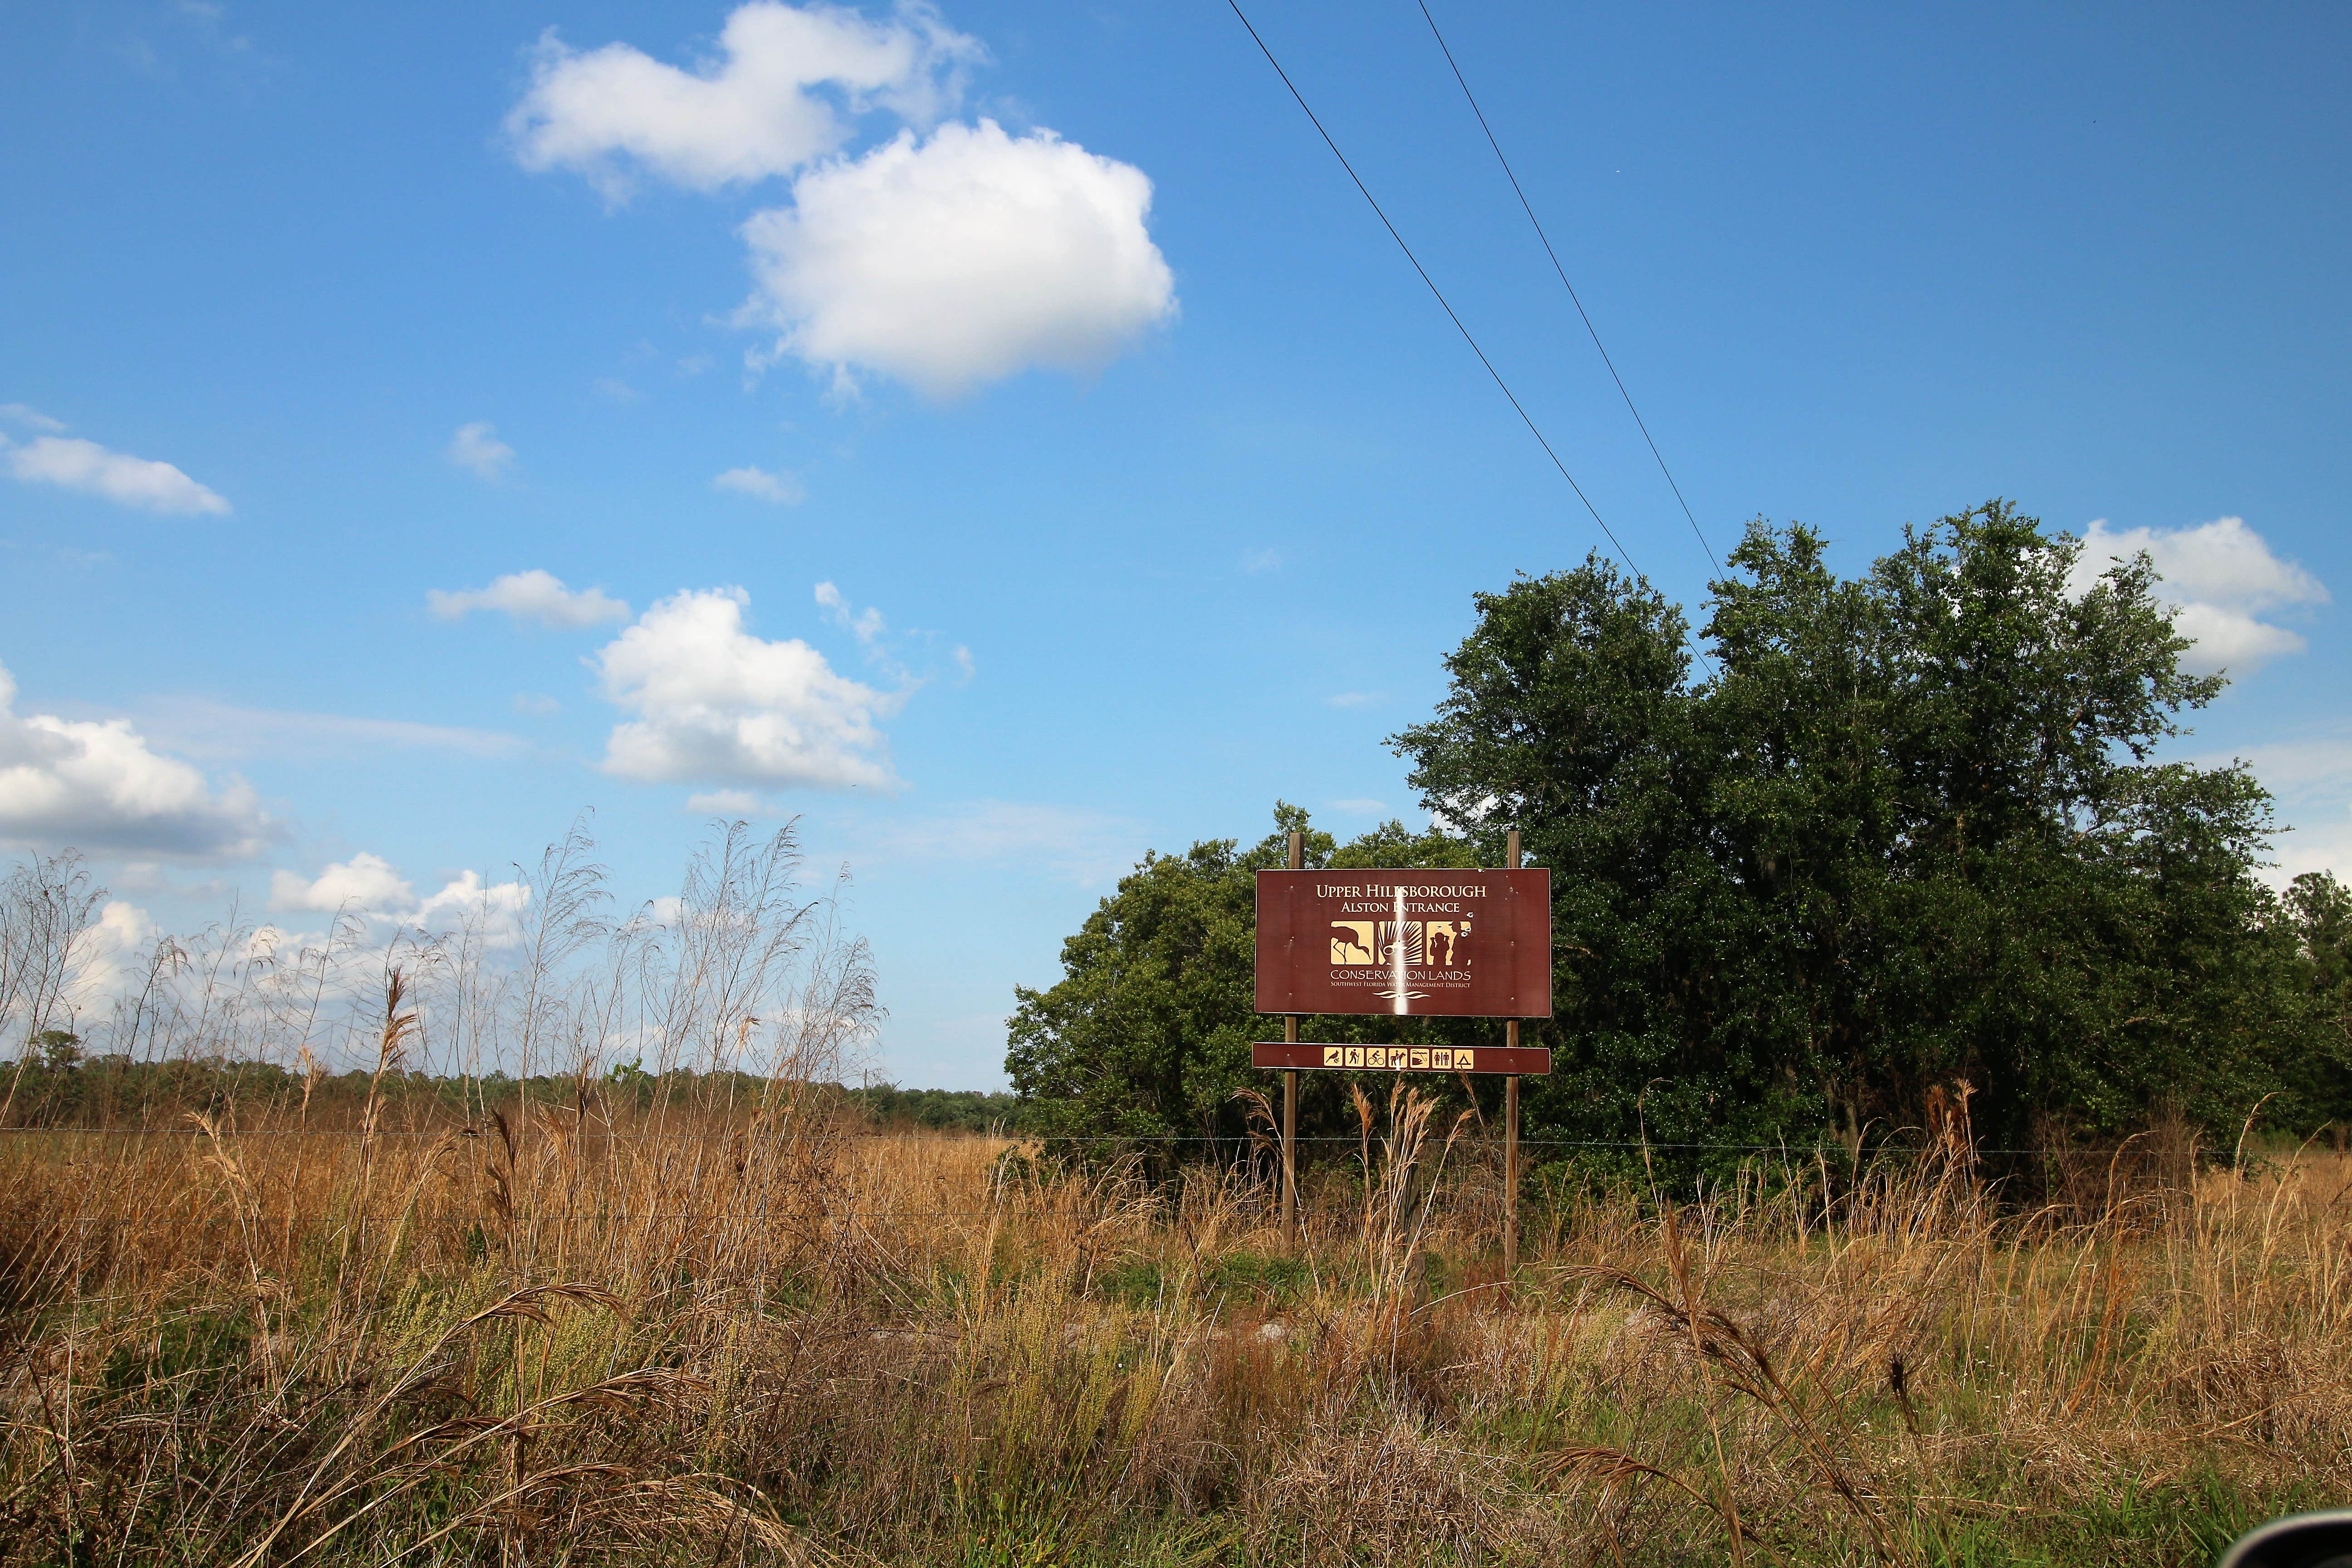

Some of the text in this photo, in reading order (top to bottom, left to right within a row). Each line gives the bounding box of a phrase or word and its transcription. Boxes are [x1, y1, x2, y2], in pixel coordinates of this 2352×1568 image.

[1316, 884, 1362, 897] UPPER
[1341, 901, 1460, 912] ALSTON ENTRANCE
[1330, 970, 1470, 980] CONSERVATION LANDS
